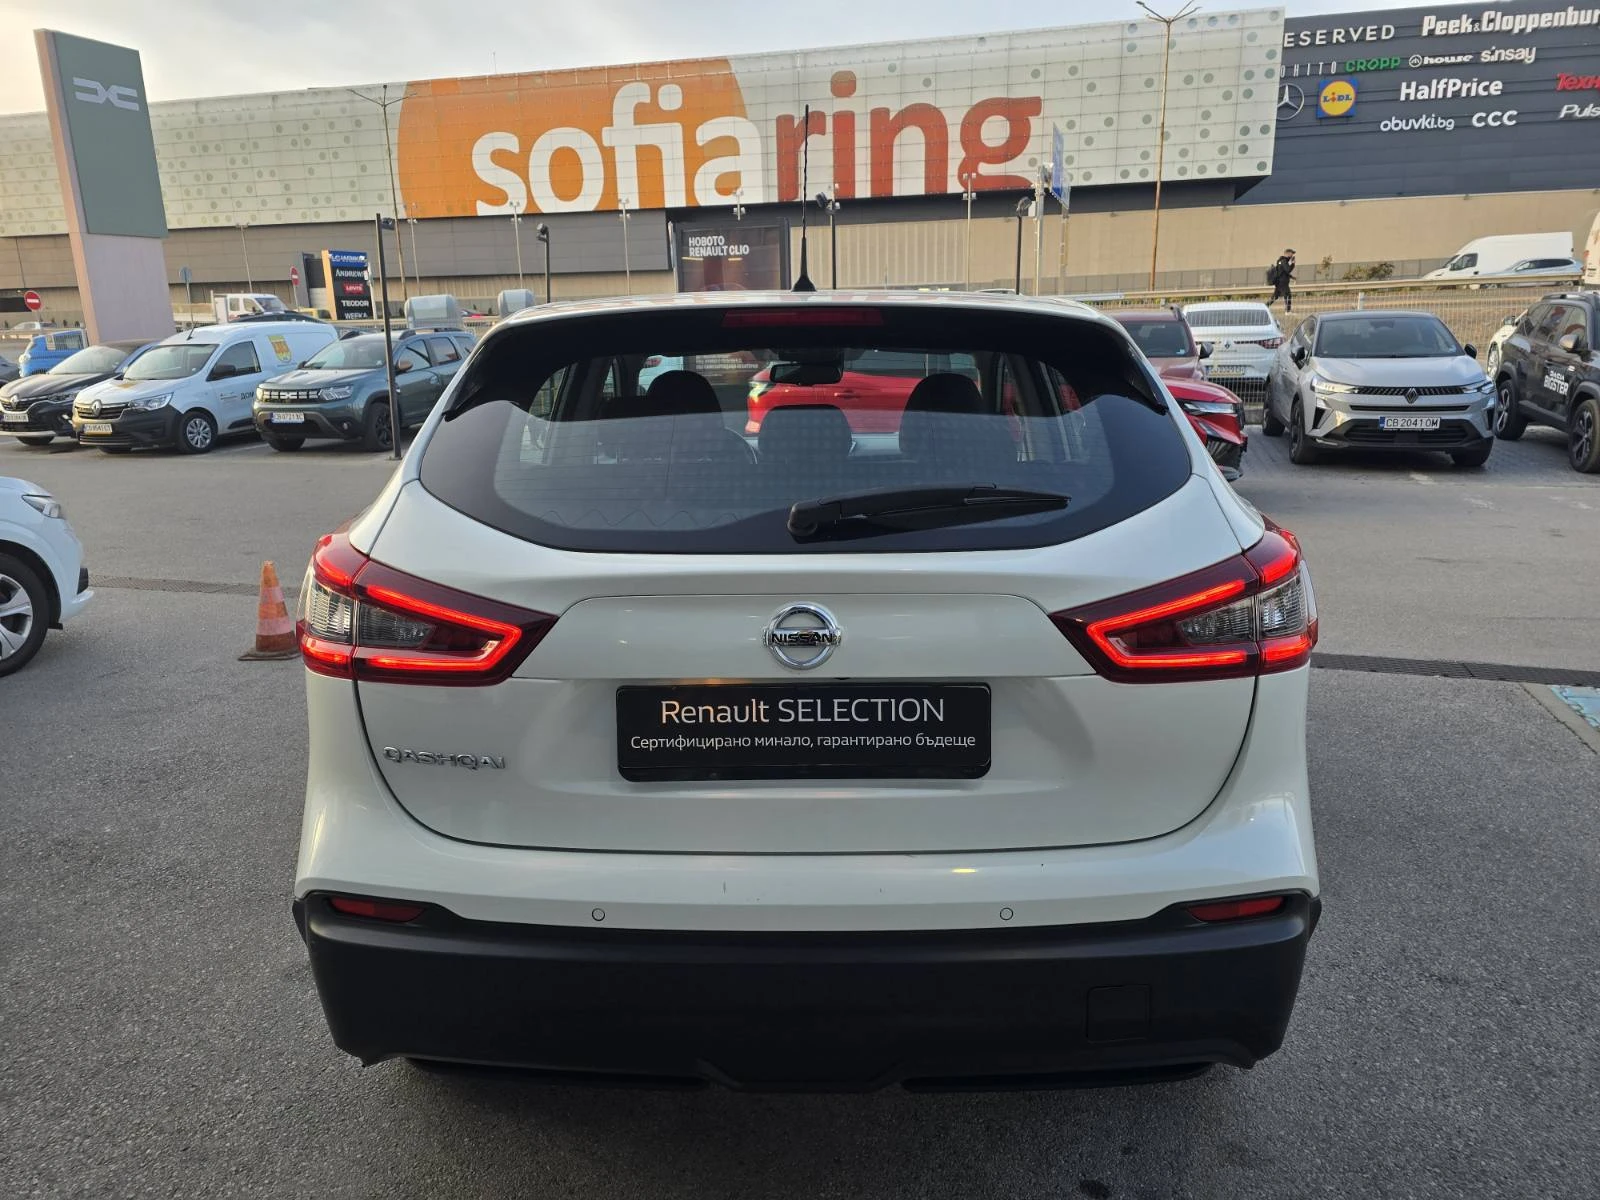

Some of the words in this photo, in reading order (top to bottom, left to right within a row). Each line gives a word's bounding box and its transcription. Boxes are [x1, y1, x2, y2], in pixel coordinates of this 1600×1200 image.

[1283, 25, 1395, 48] ESERVED
[1423, 55, 1474, 65] house
[1480, 46, 1537, 64] sinsay
[1280, 61, 1337, 79] OHITO
[1345, 56, 1401, 73] CROPP
[1556, 72, 1600, 91] Техн
[1471, 110, 1519, 128] CCC
[1558, 103, 1600, 119] Puls
[1380, 114, 1455, 132] obuvki.bg
[689, 246, 728, 257] RENAULT
[729, 244, 750, 256] CLIO
[1543, 374, 1569, 397] BIGSTER
[771, 631, 834, 644] NISSAN
[661, 698, 770, 724] Renault
[778, 698, 945, 723] SELECTION
[630, 735, 751, 751] Сертифицирано
[754, 736, 814, 748] минало,
[817, 736, 912, 749] гарантирано
[915, 732, 976, 748] бъдеще
[383, 746, 506, 771] QASHQAI
